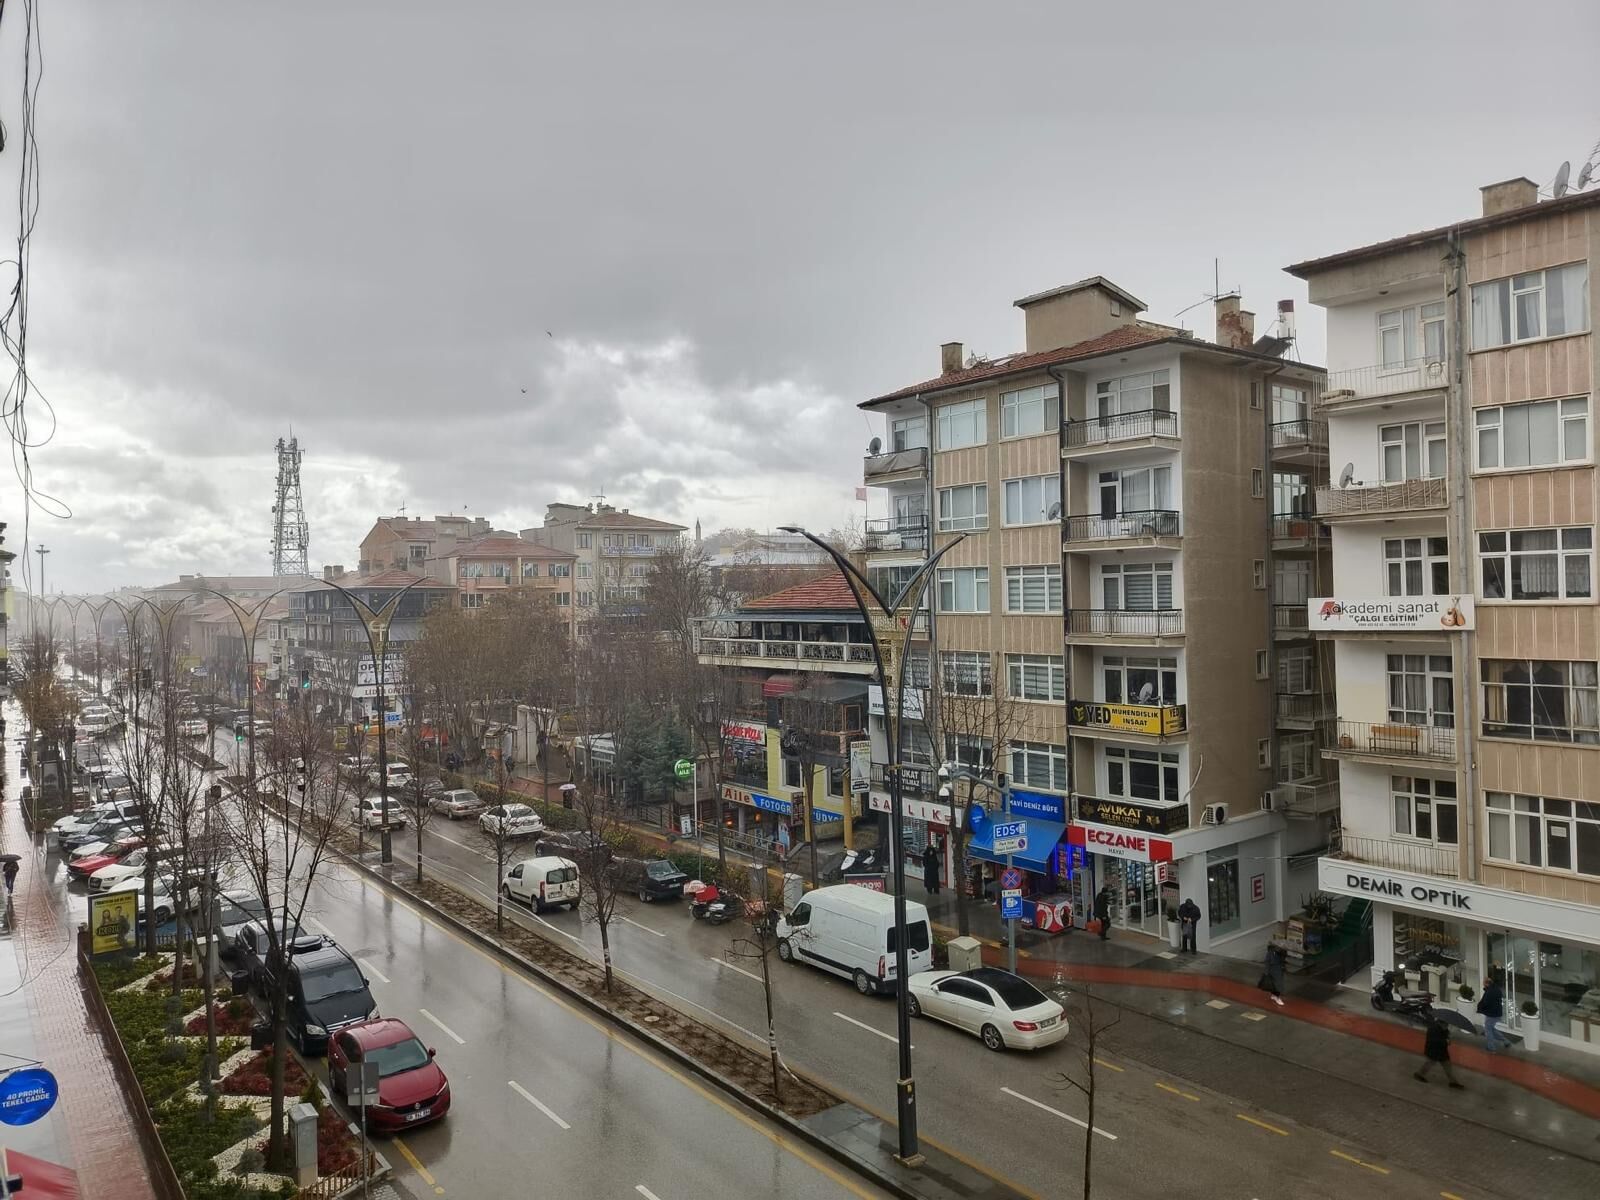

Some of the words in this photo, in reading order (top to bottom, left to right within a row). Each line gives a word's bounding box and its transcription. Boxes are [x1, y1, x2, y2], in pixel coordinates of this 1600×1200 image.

[1333, 601, 1392, 614] akademi
[1397, 601, 1439, 613] sanat
[1087, 705, 1112, 724] YED
[901, 769, 919, 780] UKAT
[724, 788, 751, 803] Aile
[872, 797, 942, 820] SALIK
[1024, 801, 1041, 810] DENİZ
[1042, 804, 1059, 813] BÜFE
[1097, 803, 1143, 818] AVUKAT
[996, 824, 1016, 837] EDS
[1087, 829, 1146, 852] ECZANE
[1108, 848, 1125, 856] HAYAT
[1253, 878, 1263, 898] E
[1346, 874, 1404, 897] DEMİR
[1411, 886, 1472, 910] OPTİK
[2, 1099, 24, 1108] TEKEL
[26, 1093, 50, 1103] CADDE
